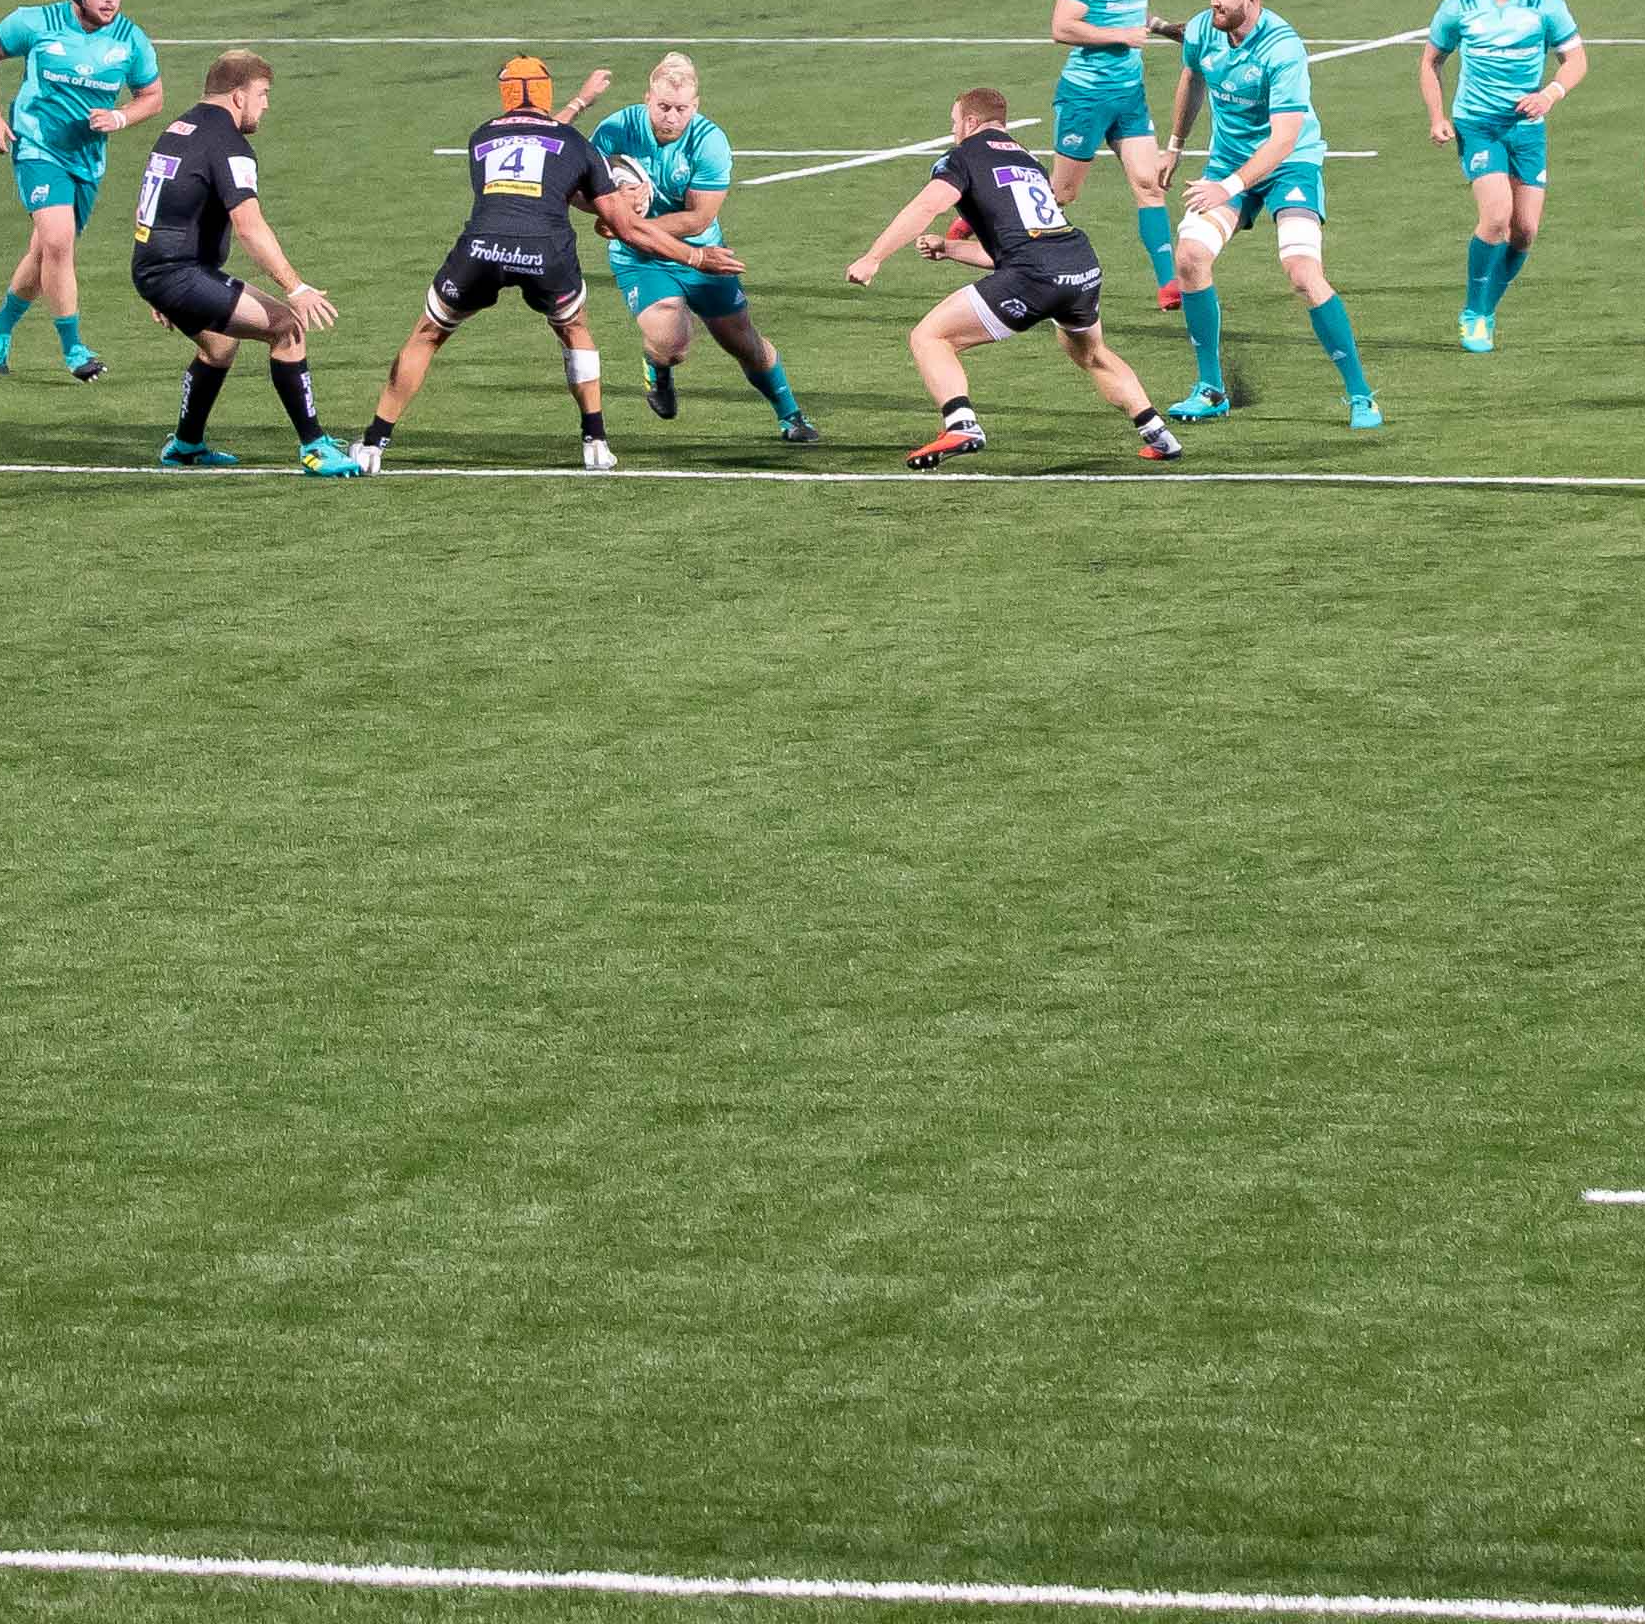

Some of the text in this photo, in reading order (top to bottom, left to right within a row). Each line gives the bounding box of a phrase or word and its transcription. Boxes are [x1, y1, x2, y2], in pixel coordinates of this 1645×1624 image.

[498, 147, 525, 173] 4
[1028, 185, 1054, 225] 8
[470, 239, 544, 266] Frobishers
